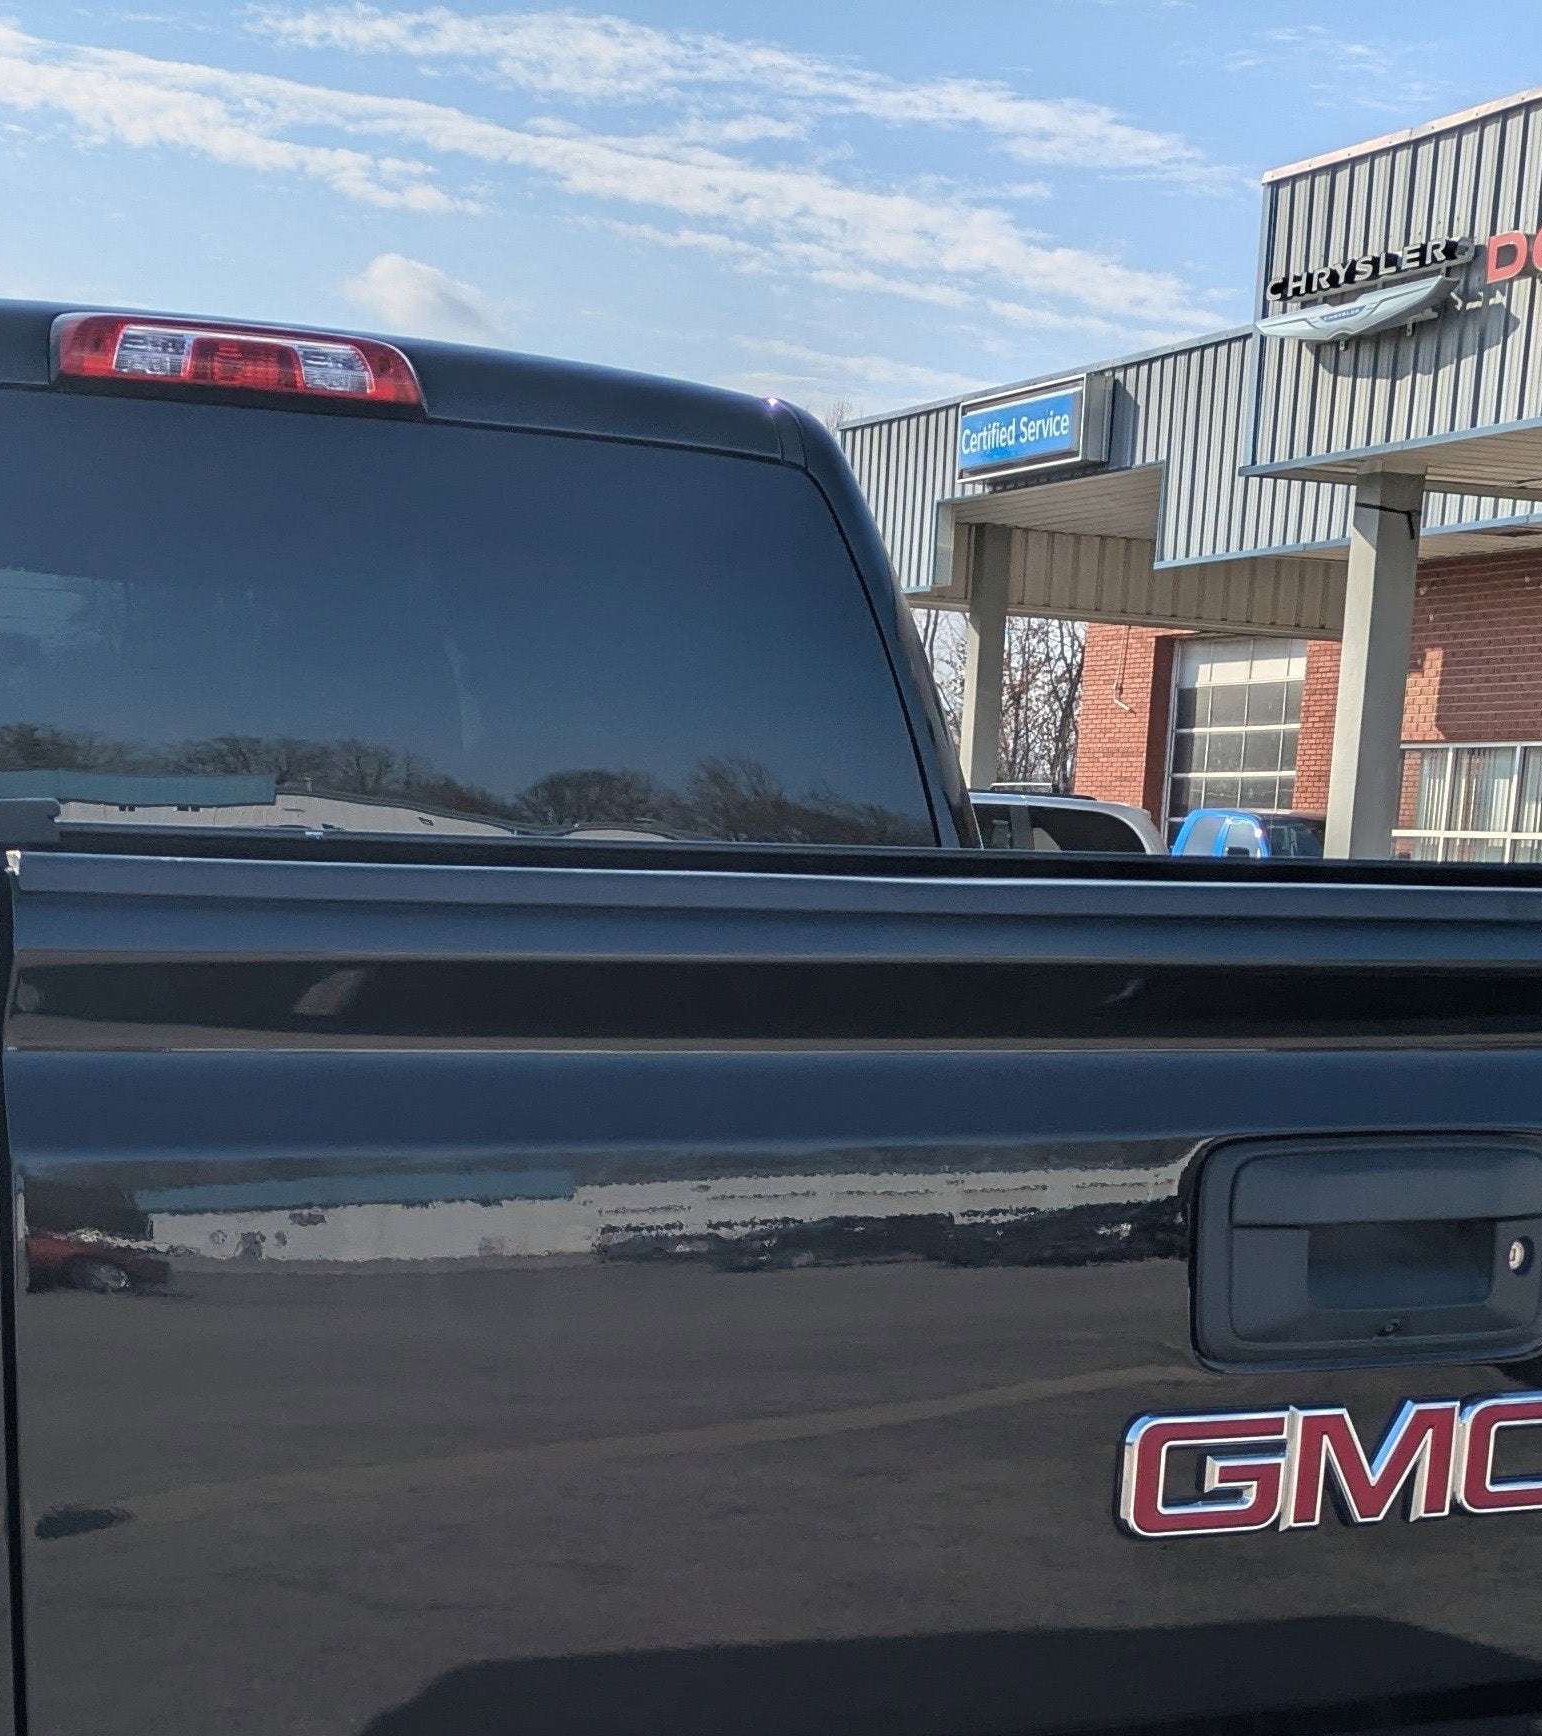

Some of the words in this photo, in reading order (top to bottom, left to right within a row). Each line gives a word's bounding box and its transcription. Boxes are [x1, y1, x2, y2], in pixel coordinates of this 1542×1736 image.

[1265, 236, 1448, 301] CHRYSLER
[961, 417, 1016, 455] Certified
[1019, 409, 1070, 444] Service
